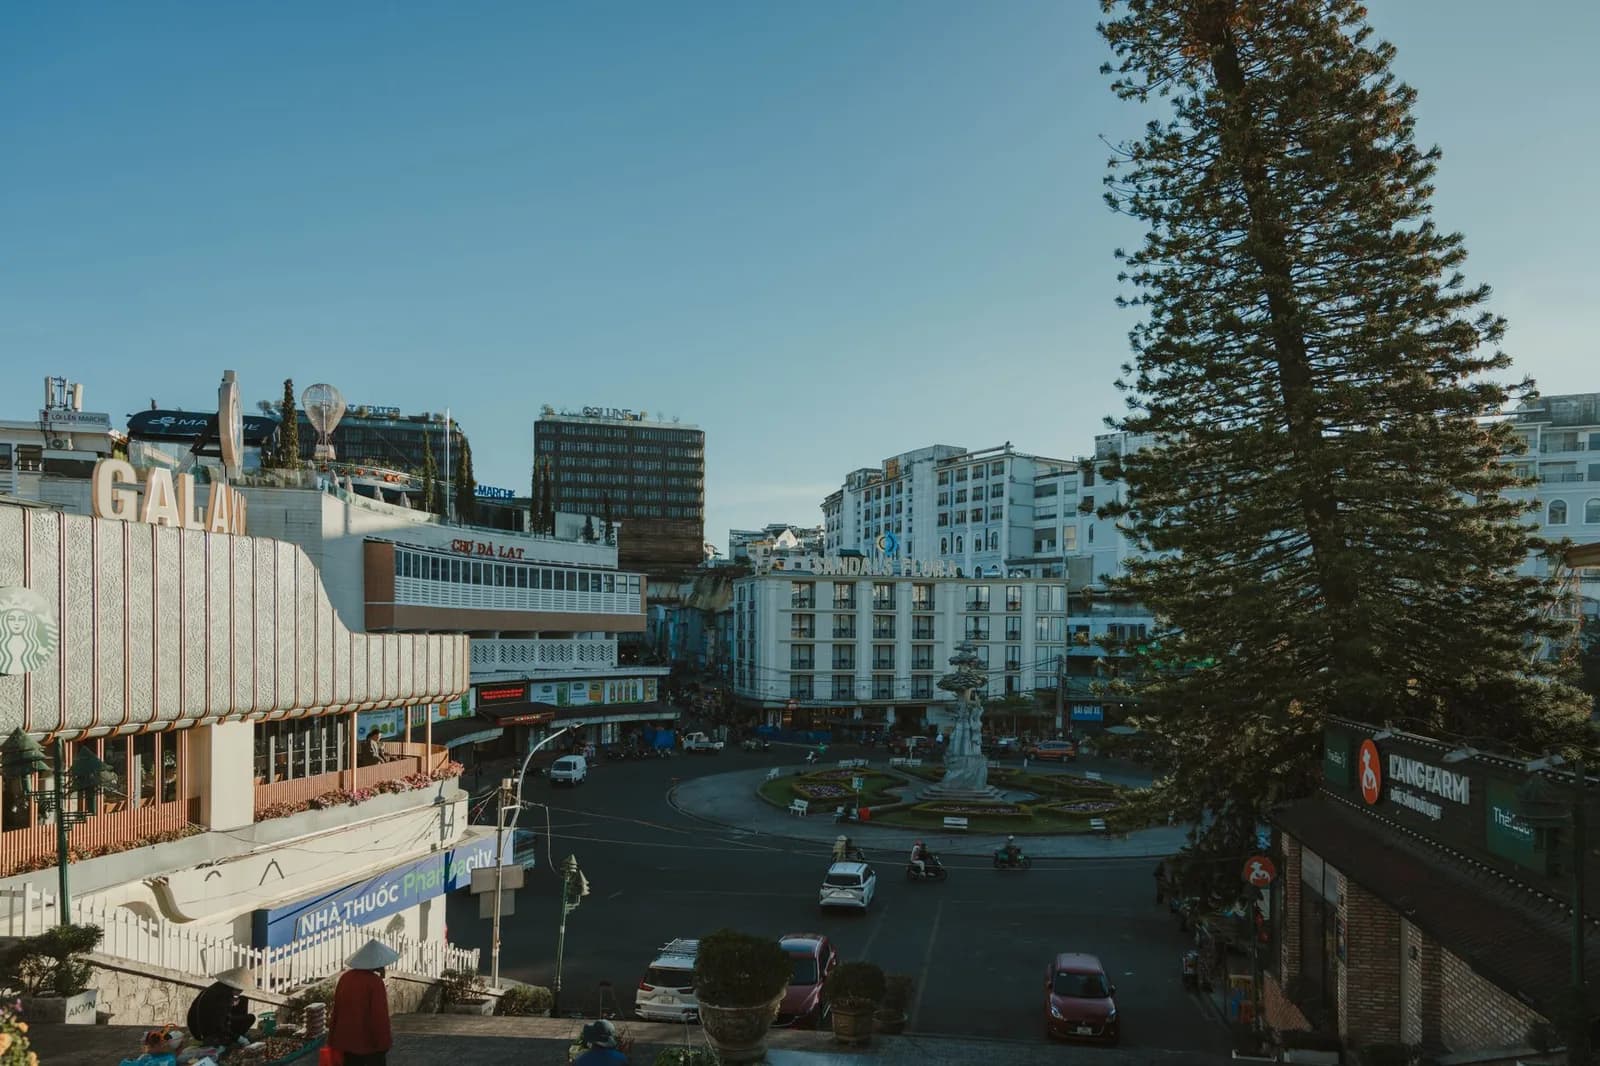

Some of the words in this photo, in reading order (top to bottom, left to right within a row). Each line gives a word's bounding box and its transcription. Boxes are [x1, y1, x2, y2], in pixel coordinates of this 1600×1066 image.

[451, 539, 474, 555] CHỢ
[301, 902, 340, 936] NHÀ
[343, 881, 400, 920] THUỐC
